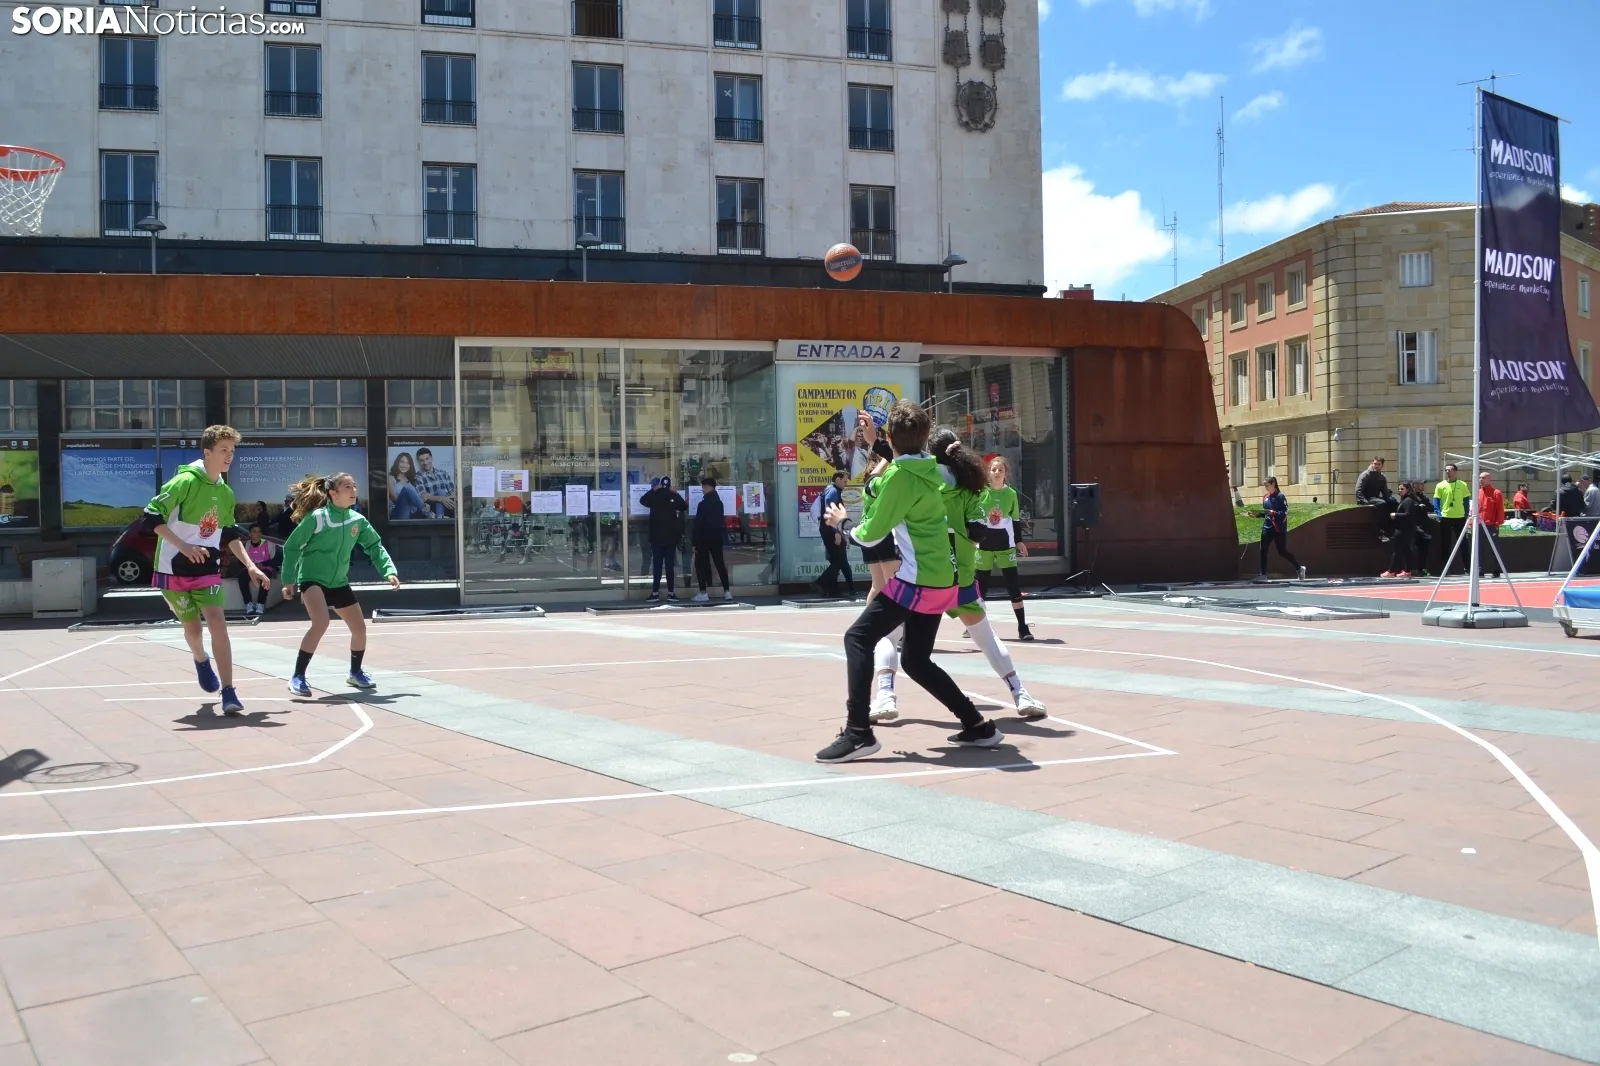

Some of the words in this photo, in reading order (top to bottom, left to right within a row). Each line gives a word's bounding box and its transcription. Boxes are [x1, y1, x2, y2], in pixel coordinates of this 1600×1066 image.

[1491, 139, 1553, 177] MADISON
[1485, 247, 1551, 282] MADISON
[797, 344, 885, 358] ENTRADA
[890, 346, 900, 358] 2
[1489, 359, 1565, 382] MADISON
[797, 388, 857, 400] CAMPAMENTOS
[209, 584, 221, 595] 17
